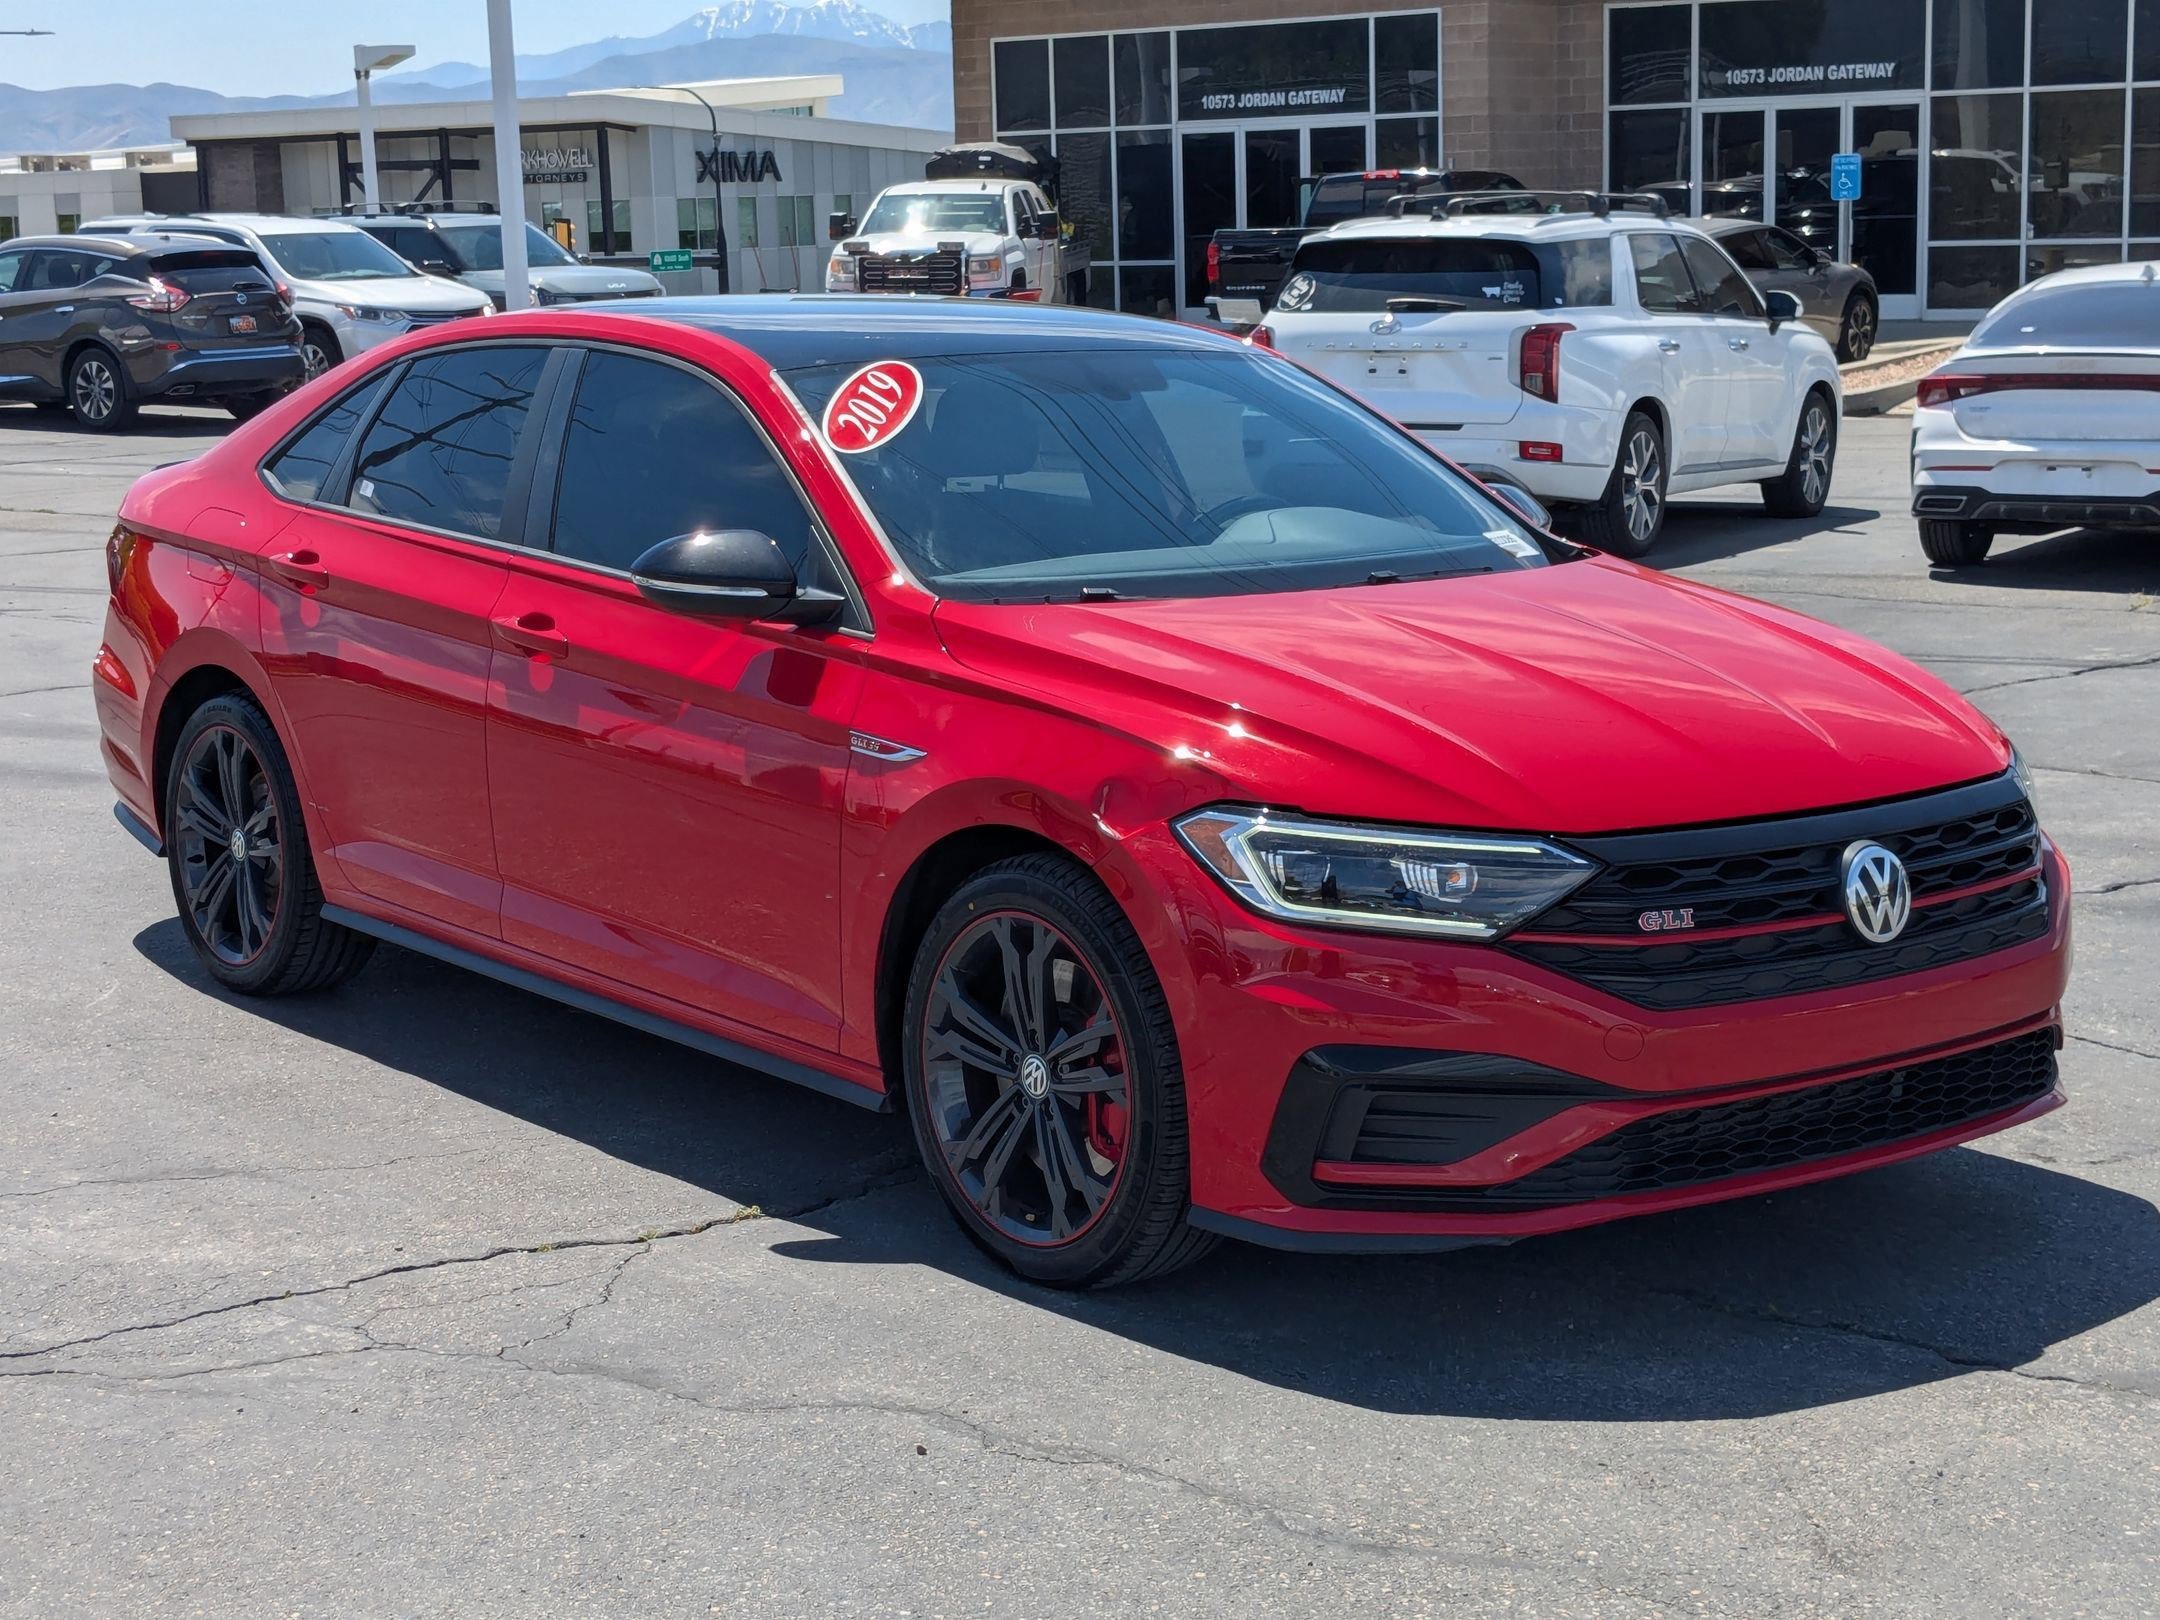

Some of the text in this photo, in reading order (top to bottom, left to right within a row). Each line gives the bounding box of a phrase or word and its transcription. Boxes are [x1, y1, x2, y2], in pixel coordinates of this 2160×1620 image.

[1725, 62, 1896, 85] 10573 JORDAN GATEWAY
[1201, 88, 1346, 110] 10573 JORDAN GATEWAY
[695, 150, 783, 183] XIMA
[838, 371, 903, 442] 2019
[1638, 908, 1695, 931] GLI
